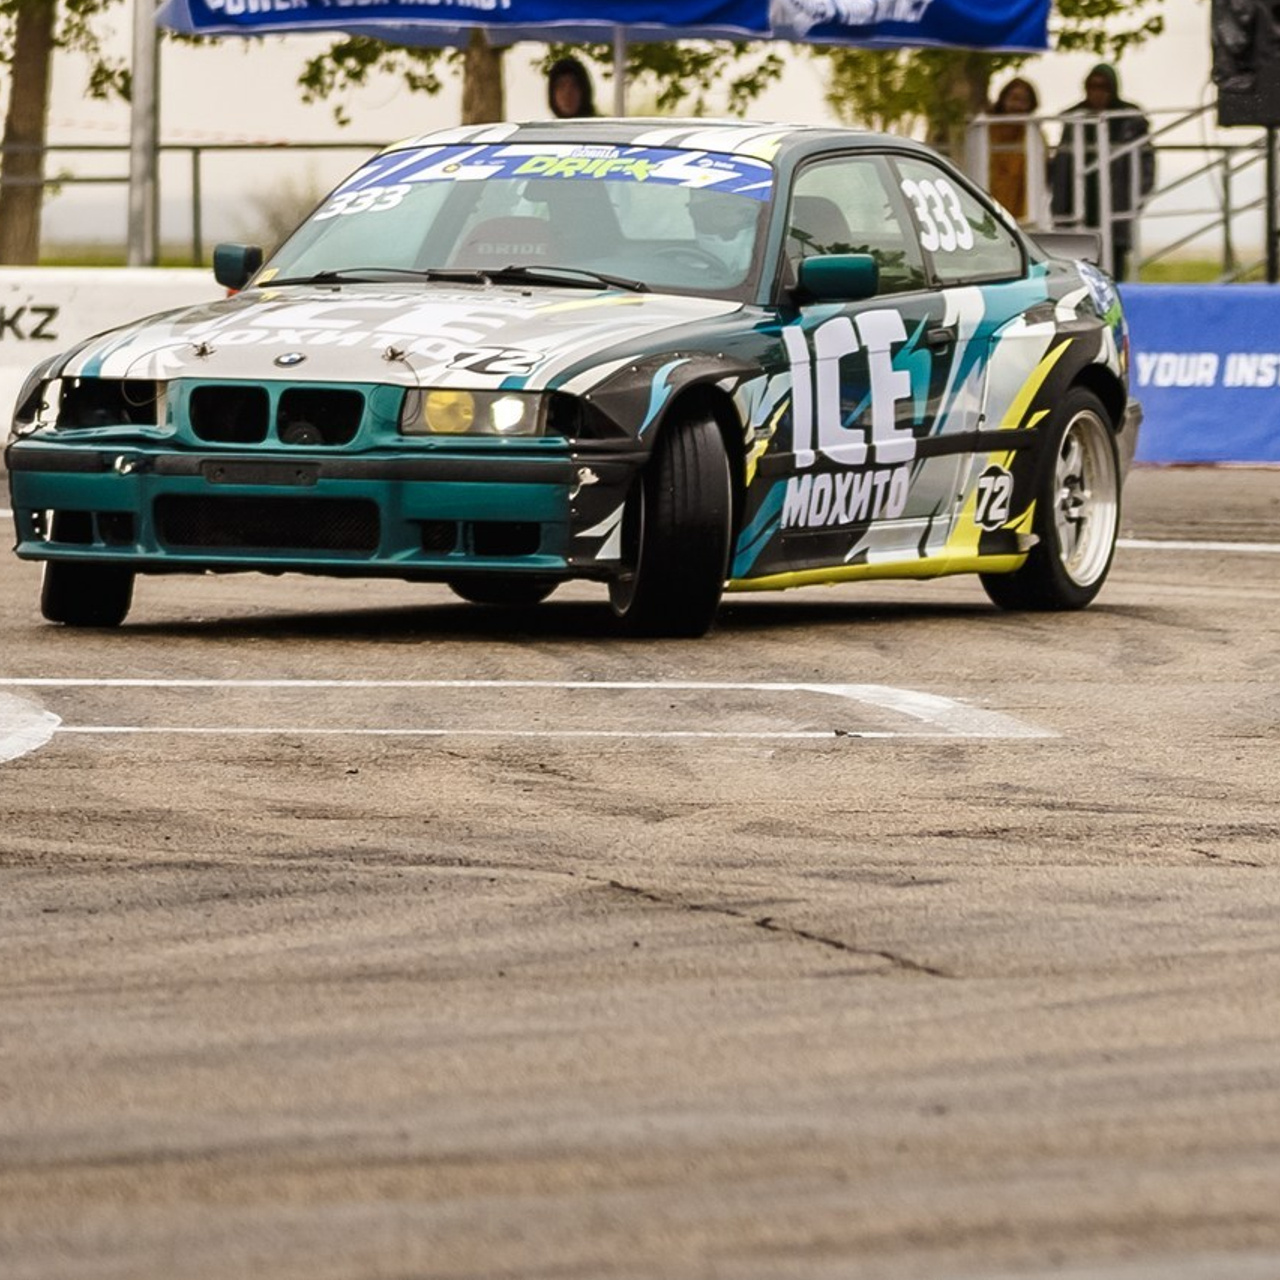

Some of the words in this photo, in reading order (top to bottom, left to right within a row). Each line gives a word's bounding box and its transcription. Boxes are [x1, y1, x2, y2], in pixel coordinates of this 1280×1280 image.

[313, 184, 412, 221] 333
[901, 179, 974, 252] 333
[447, 347, 544, 374] 72
[1135, 352, 1219, 387] YOUR
[781, 309, 917, 468] ICE
[975, 475, 1011, 522] 72
